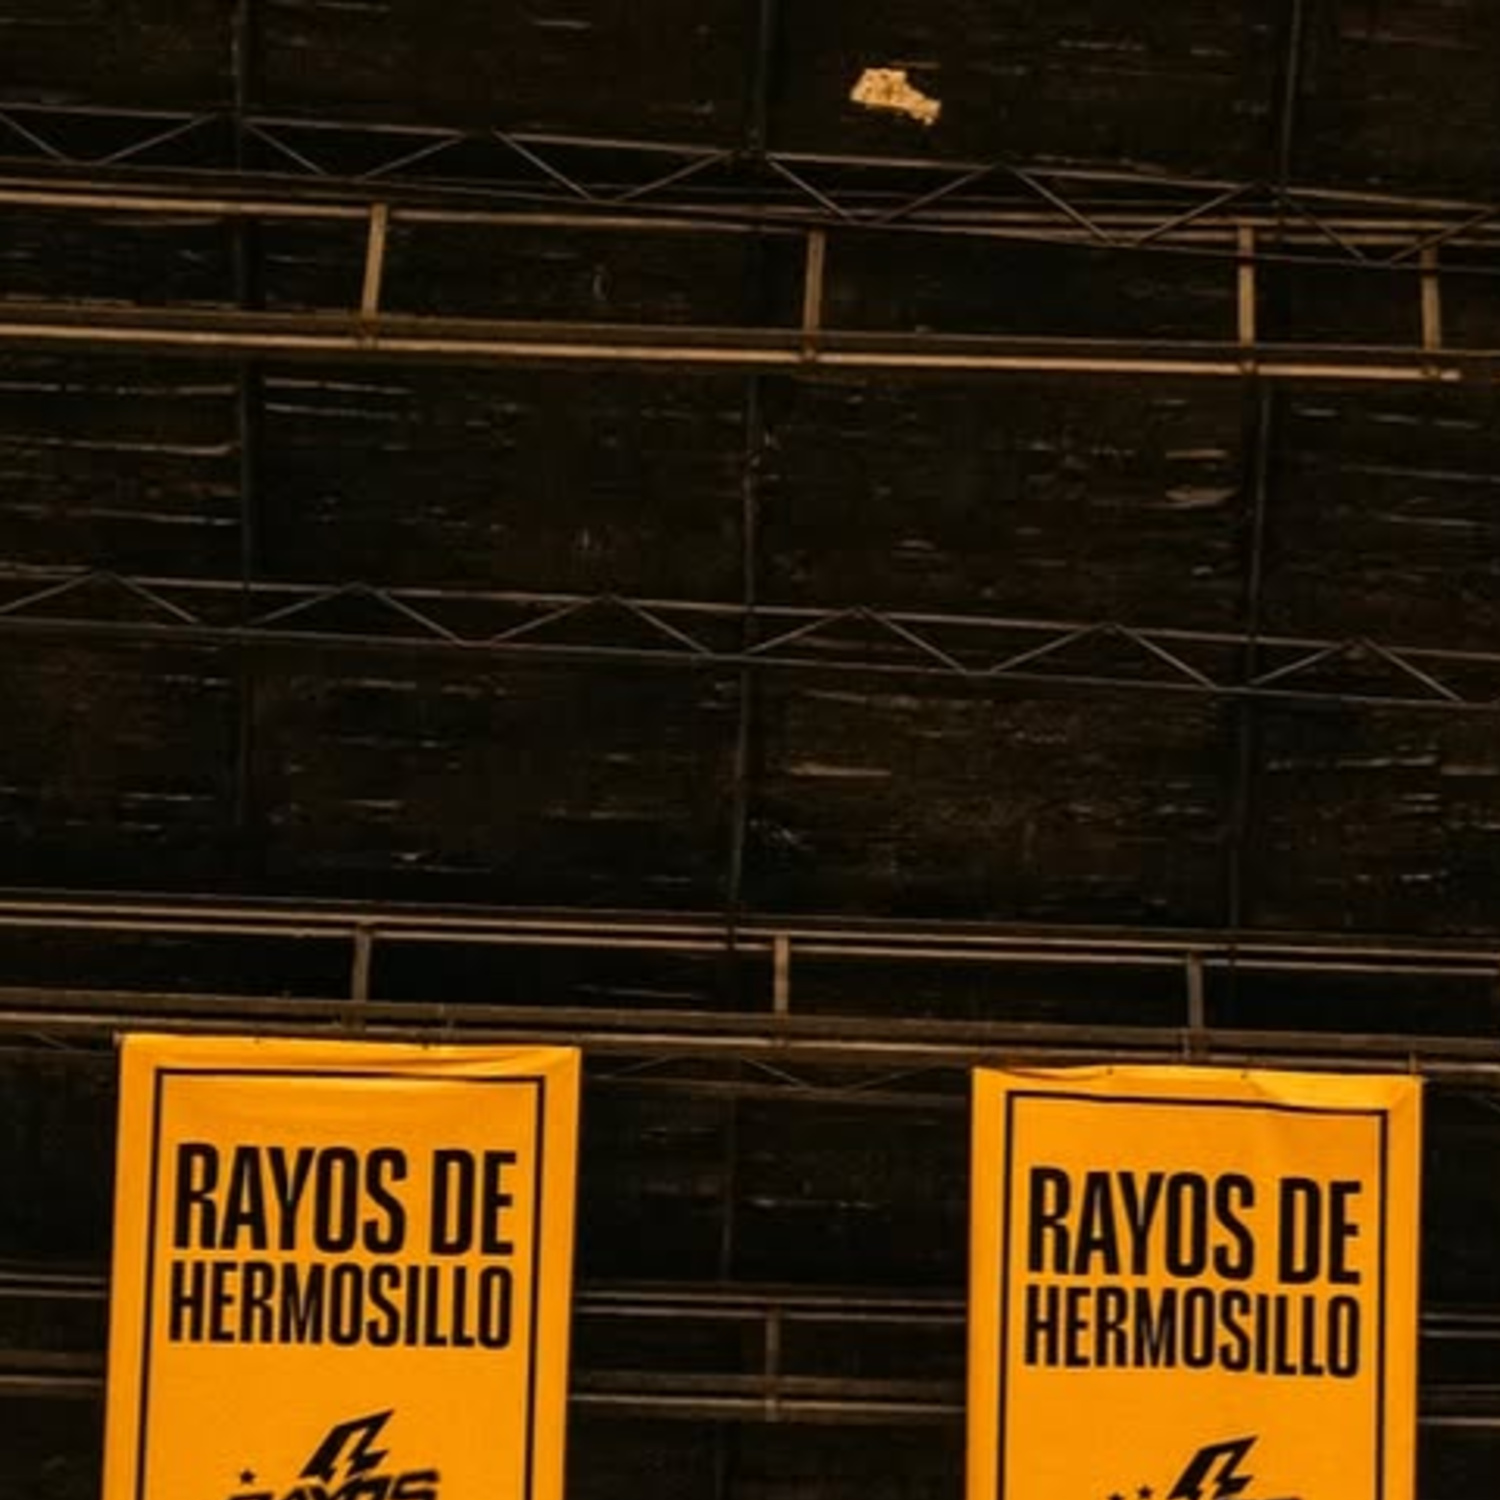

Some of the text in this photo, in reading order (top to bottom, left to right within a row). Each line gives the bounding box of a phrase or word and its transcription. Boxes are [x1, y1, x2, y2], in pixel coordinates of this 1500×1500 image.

[173, 1142, 517, 1257] RAYOS DE
[1028, 1166, 1361, 1286] RAYOS DE
[169, 1260, 513, 1349] HERMOSILLO
[1025, 1285, 1360, 1379] HERMOSILLO
